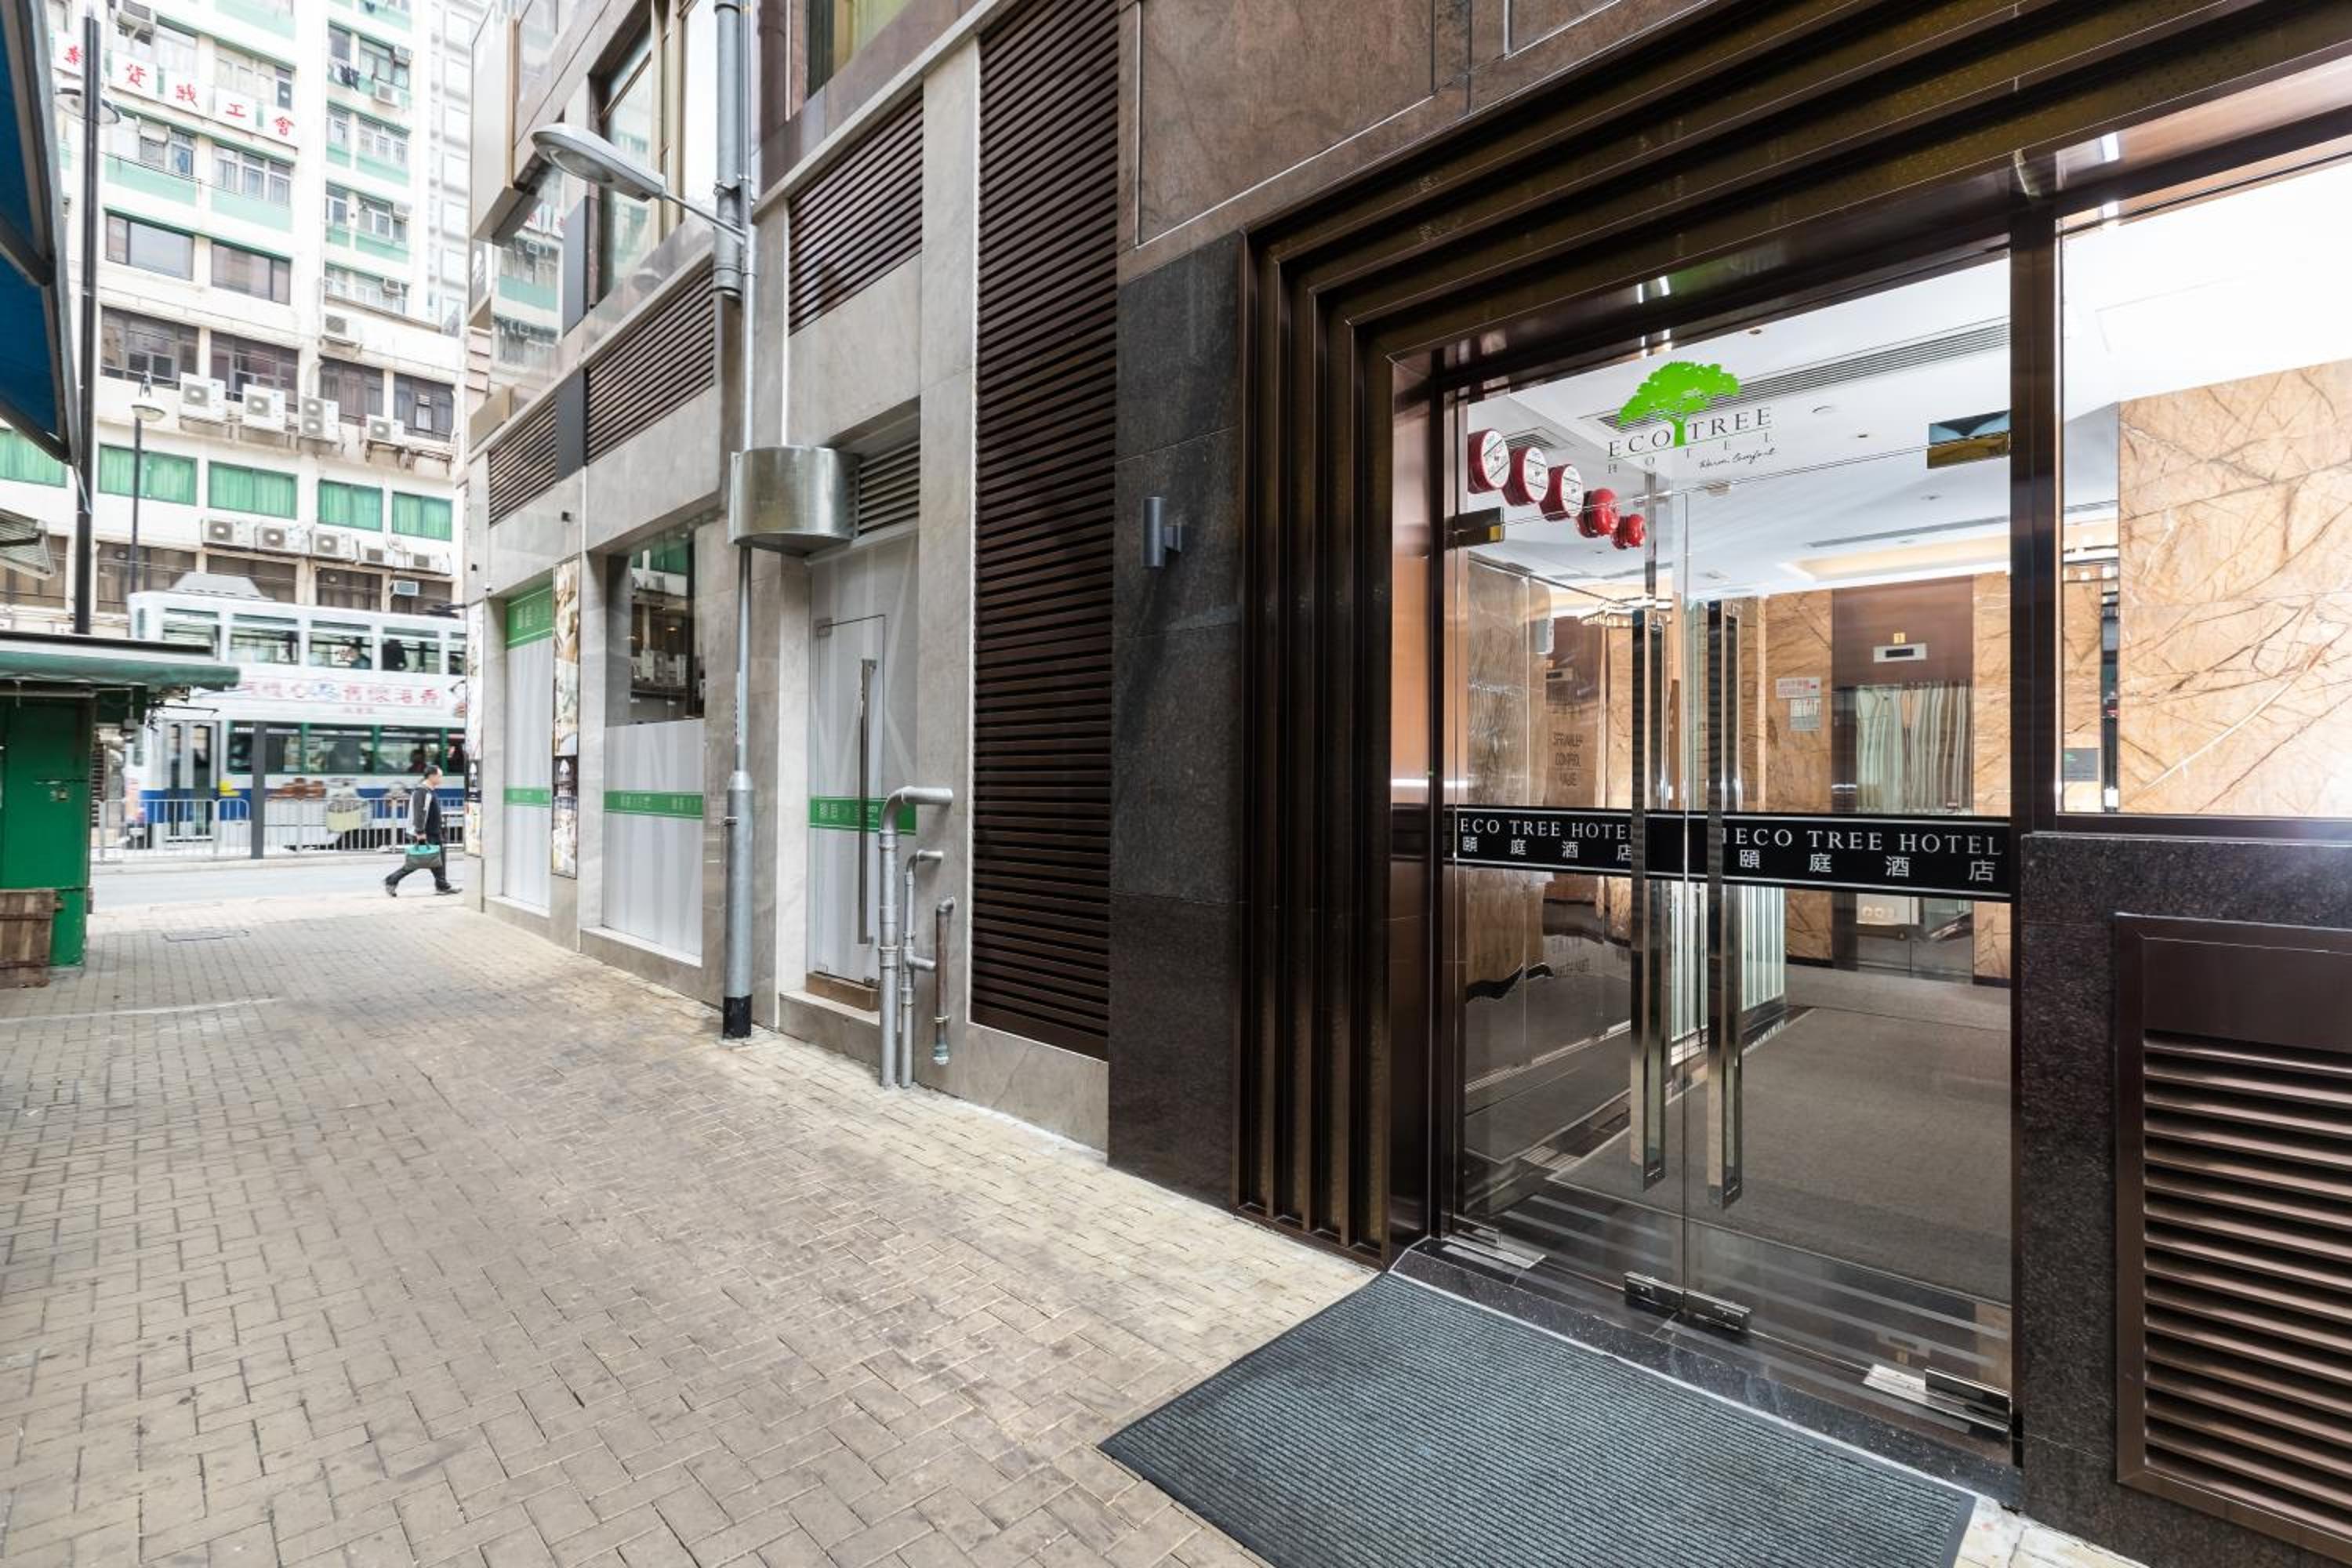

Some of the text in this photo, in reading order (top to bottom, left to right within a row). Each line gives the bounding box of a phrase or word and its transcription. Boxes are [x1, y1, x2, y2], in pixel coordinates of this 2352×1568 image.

[1609, 406, 1772, 457] ECO TREE
[1460, 818, 1500, 834] ECO
[1509, 820, 1561, 837] TREE
[1735, 827, 2002, 855] ECO TREE HOTEL
[1740, 849, 1996, 882] 頤庭酒店
